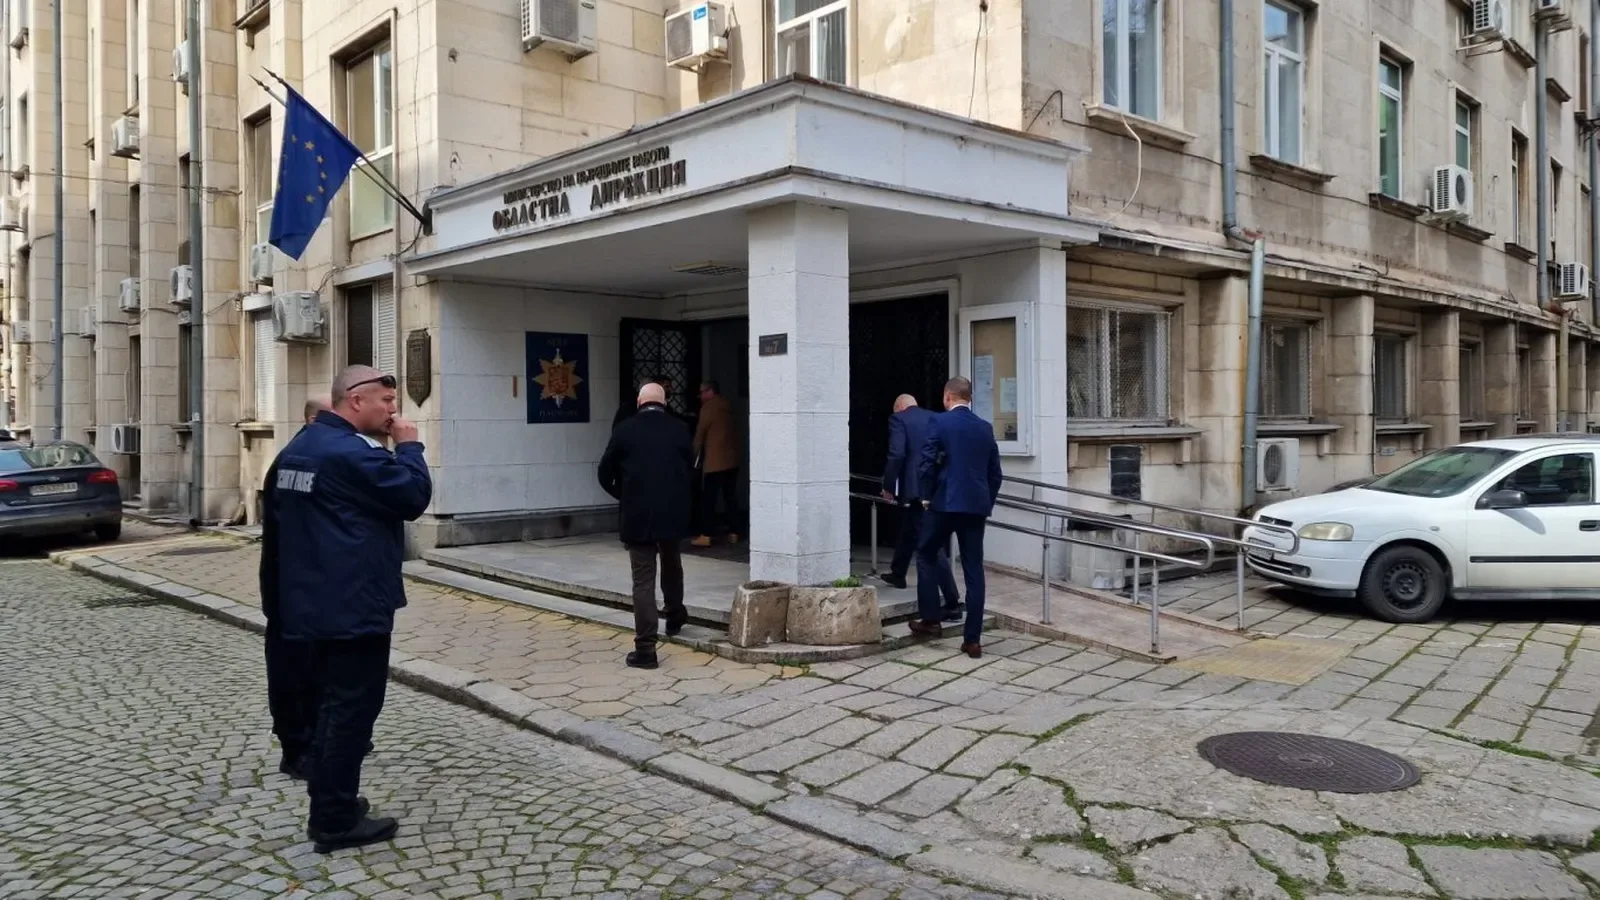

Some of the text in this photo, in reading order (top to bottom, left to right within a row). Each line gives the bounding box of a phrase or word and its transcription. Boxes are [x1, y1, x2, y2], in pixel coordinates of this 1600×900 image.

[492, 159, 687, 231] ОБЛАСТНА ДИРЕКЦИЯ
[563, 174, 576, 188] НА
[632, 145, 670, 169] РАБОТИ
